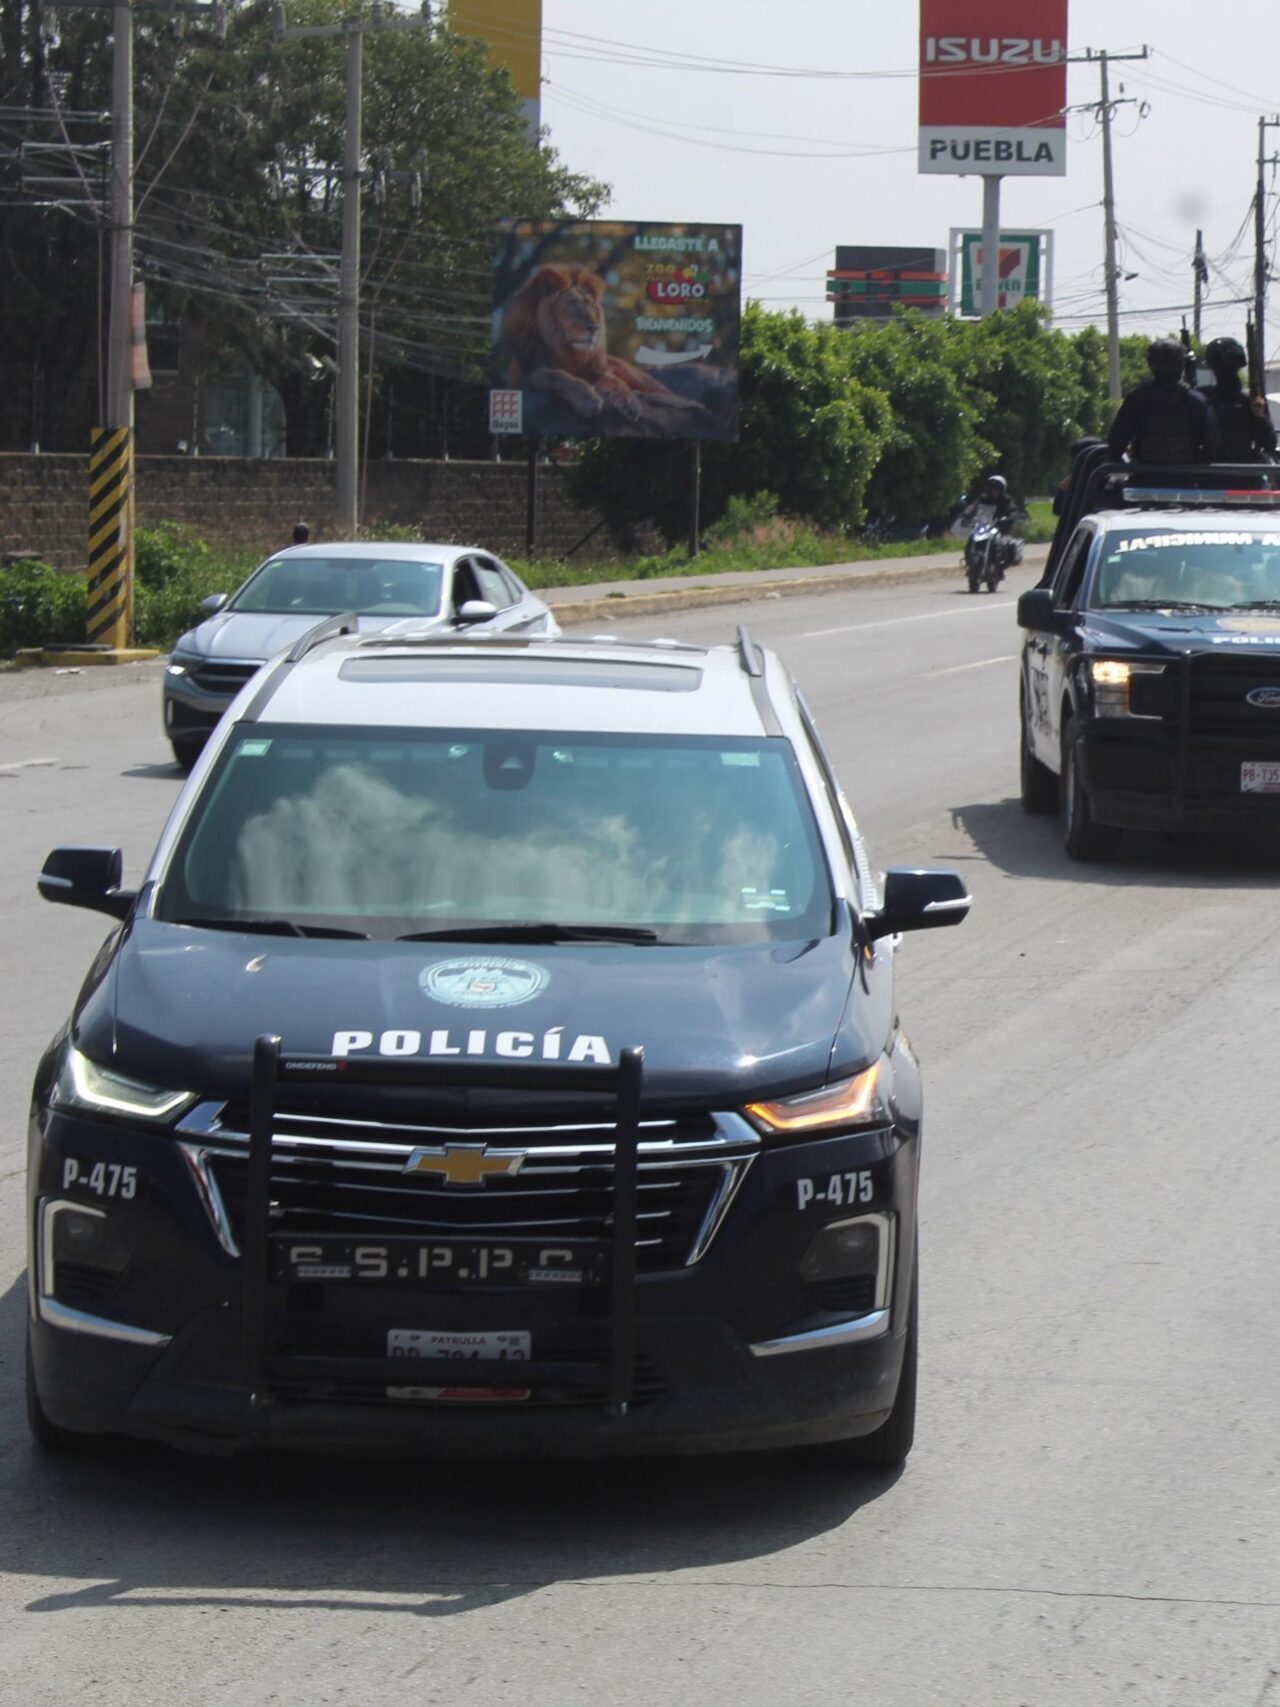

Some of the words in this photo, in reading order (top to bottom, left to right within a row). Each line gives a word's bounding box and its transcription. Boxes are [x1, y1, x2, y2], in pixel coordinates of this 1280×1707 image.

[926, 37, 1061, 63] ISUZU
[929, 139, 1055, 163] PUEBLA
[634, 235, 704, 252] LLEGASTE
[707, 238, 720, 253] A
[656, 282, 705, 298] LORO
[635, 315, 714, 333] BIENVENIDOS
[332, 1026, 612, 1065] POLICÍA
[62, 1157, 138, 1199] P-475
[797, 1170, 874, 1211] P-475
[431, 1335, 487, 1345] PATRULLA
